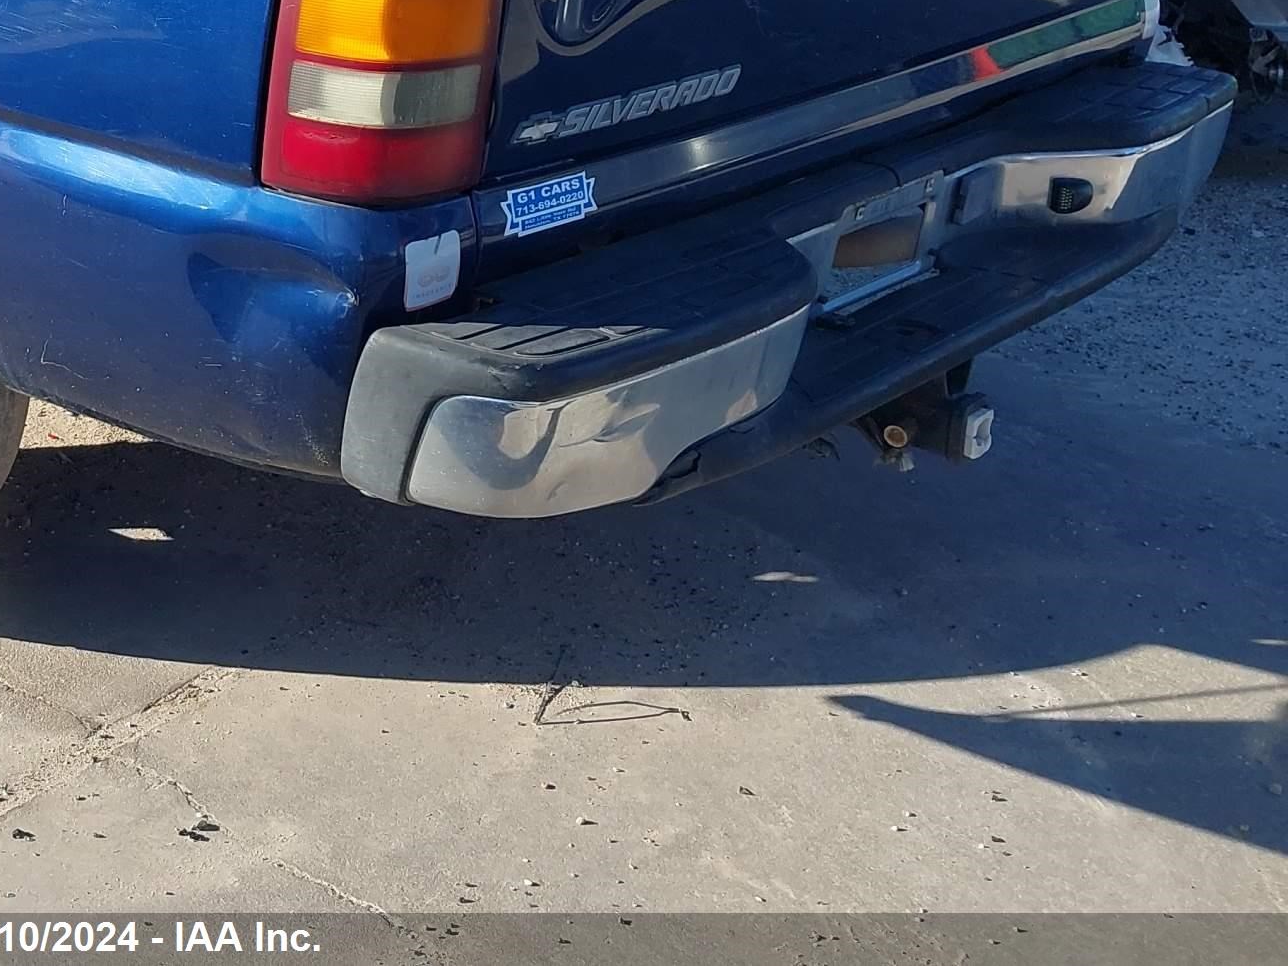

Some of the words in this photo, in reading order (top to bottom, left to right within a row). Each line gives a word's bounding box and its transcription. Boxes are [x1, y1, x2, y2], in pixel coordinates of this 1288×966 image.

[559, 63, 743, 138] SILVERADO
[515, 191, 584, 216] 713-694-0220
[517, 189, 536, 204] G1
[541, 179, 580, 197] CARS
